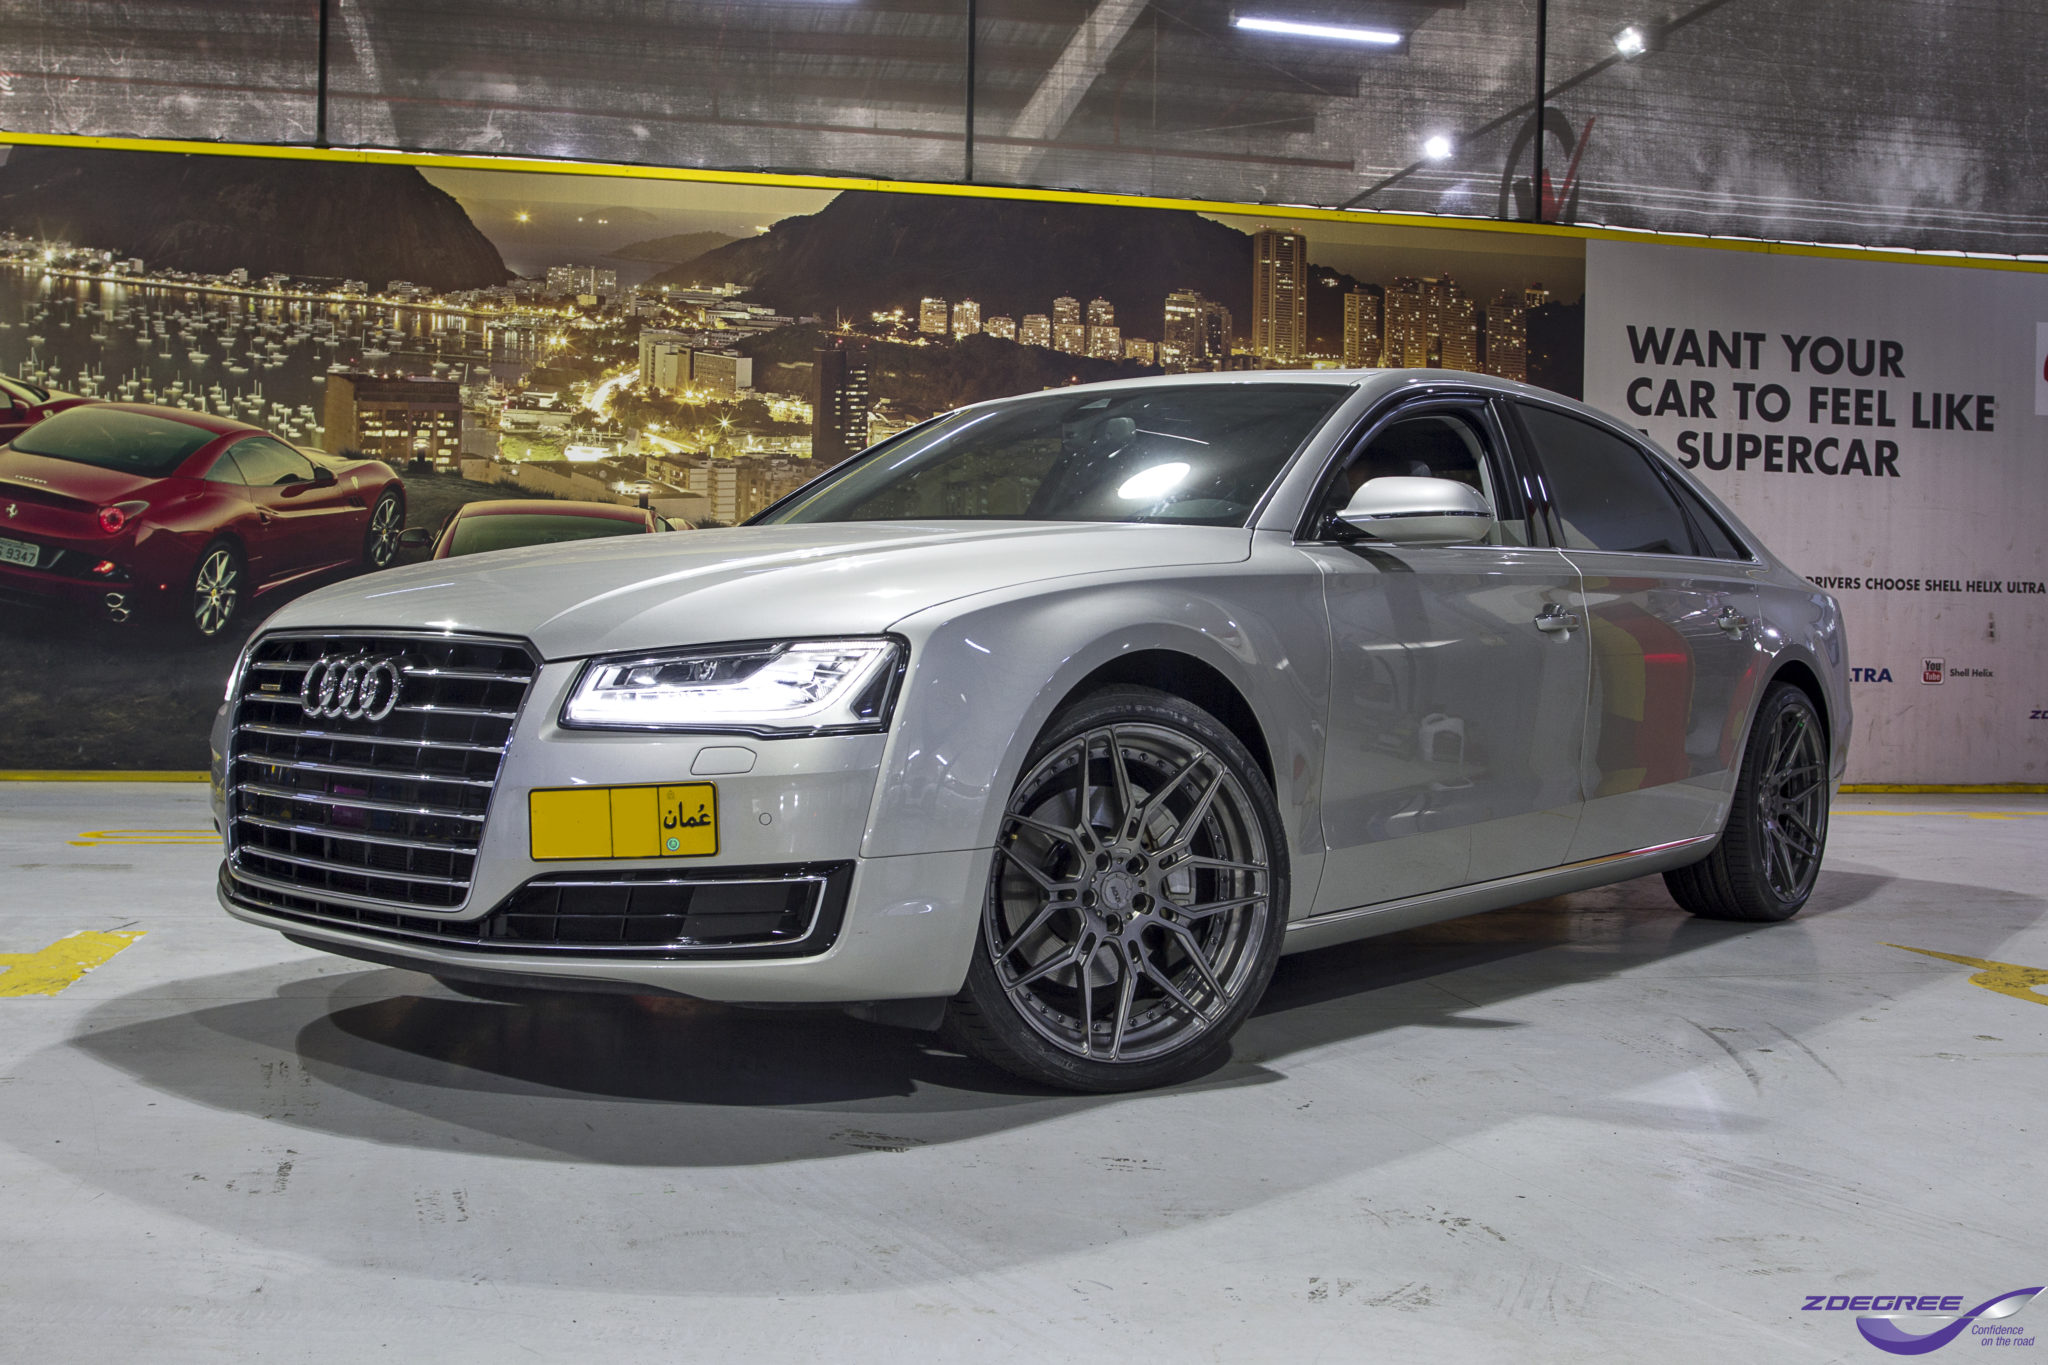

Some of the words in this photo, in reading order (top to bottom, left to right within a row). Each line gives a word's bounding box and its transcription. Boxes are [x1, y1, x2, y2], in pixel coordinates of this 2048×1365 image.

[1626, 324, 1767, 370] WANT
[1780, 334, 1906, 378] YOUR
[1626, 377, 1718, 419] CAR
[1732, 382, 1791, 422] TO
[1809, 386, 1896, 427] FEEL
[1912, 391, 1995, 432] LIKE
[1677, 430, 1900, 477] SUPERCAR
[5, 547, 36, 563] 9347
[1865, 578, 1921, 591] CHOOSE
[1924, 579, 1963, 592] SHELL
[1966, 580, 2003, 593] HELIX
[2006, 581, 2047, 594] ULTRA
[1924, 660, 1942, 671] You
[1949, 668, 1970, 677] Shell
[1971, 668, 1994, 678] Helix
[1849, 667, 1893, 683] TRA
[1924, 672, 1941, 681] Tube
